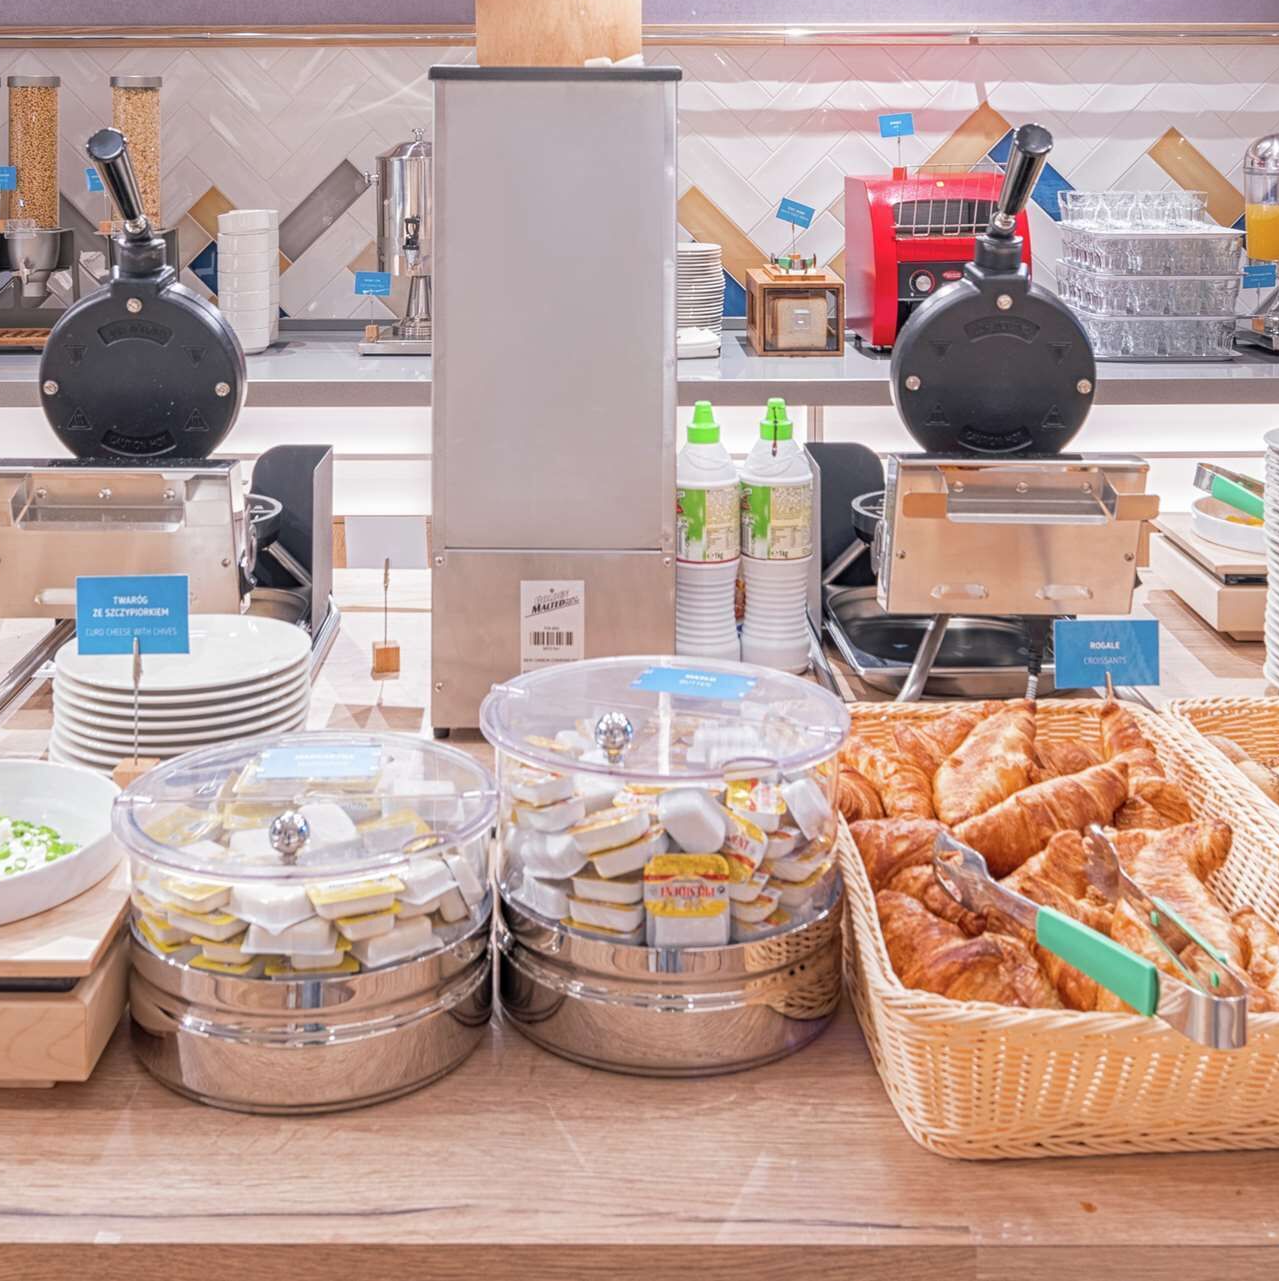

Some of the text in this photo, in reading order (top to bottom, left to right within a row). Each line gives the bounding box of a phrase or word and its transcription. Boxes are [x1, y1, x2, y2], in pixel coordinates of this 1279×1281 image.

[113, 594, 149, 605] TWARÓG
[105, 607, 169, 617] SZCZYPIORKIEM
[106, 627, 131, 636] CHEESE
[133, 626, 152, 636] WITH
[153, 627, 176, 636] CHIVES
[1089, 641, 1121, 650] ROGALE
[1083, 656, 1127, 665] CROISSANTS
